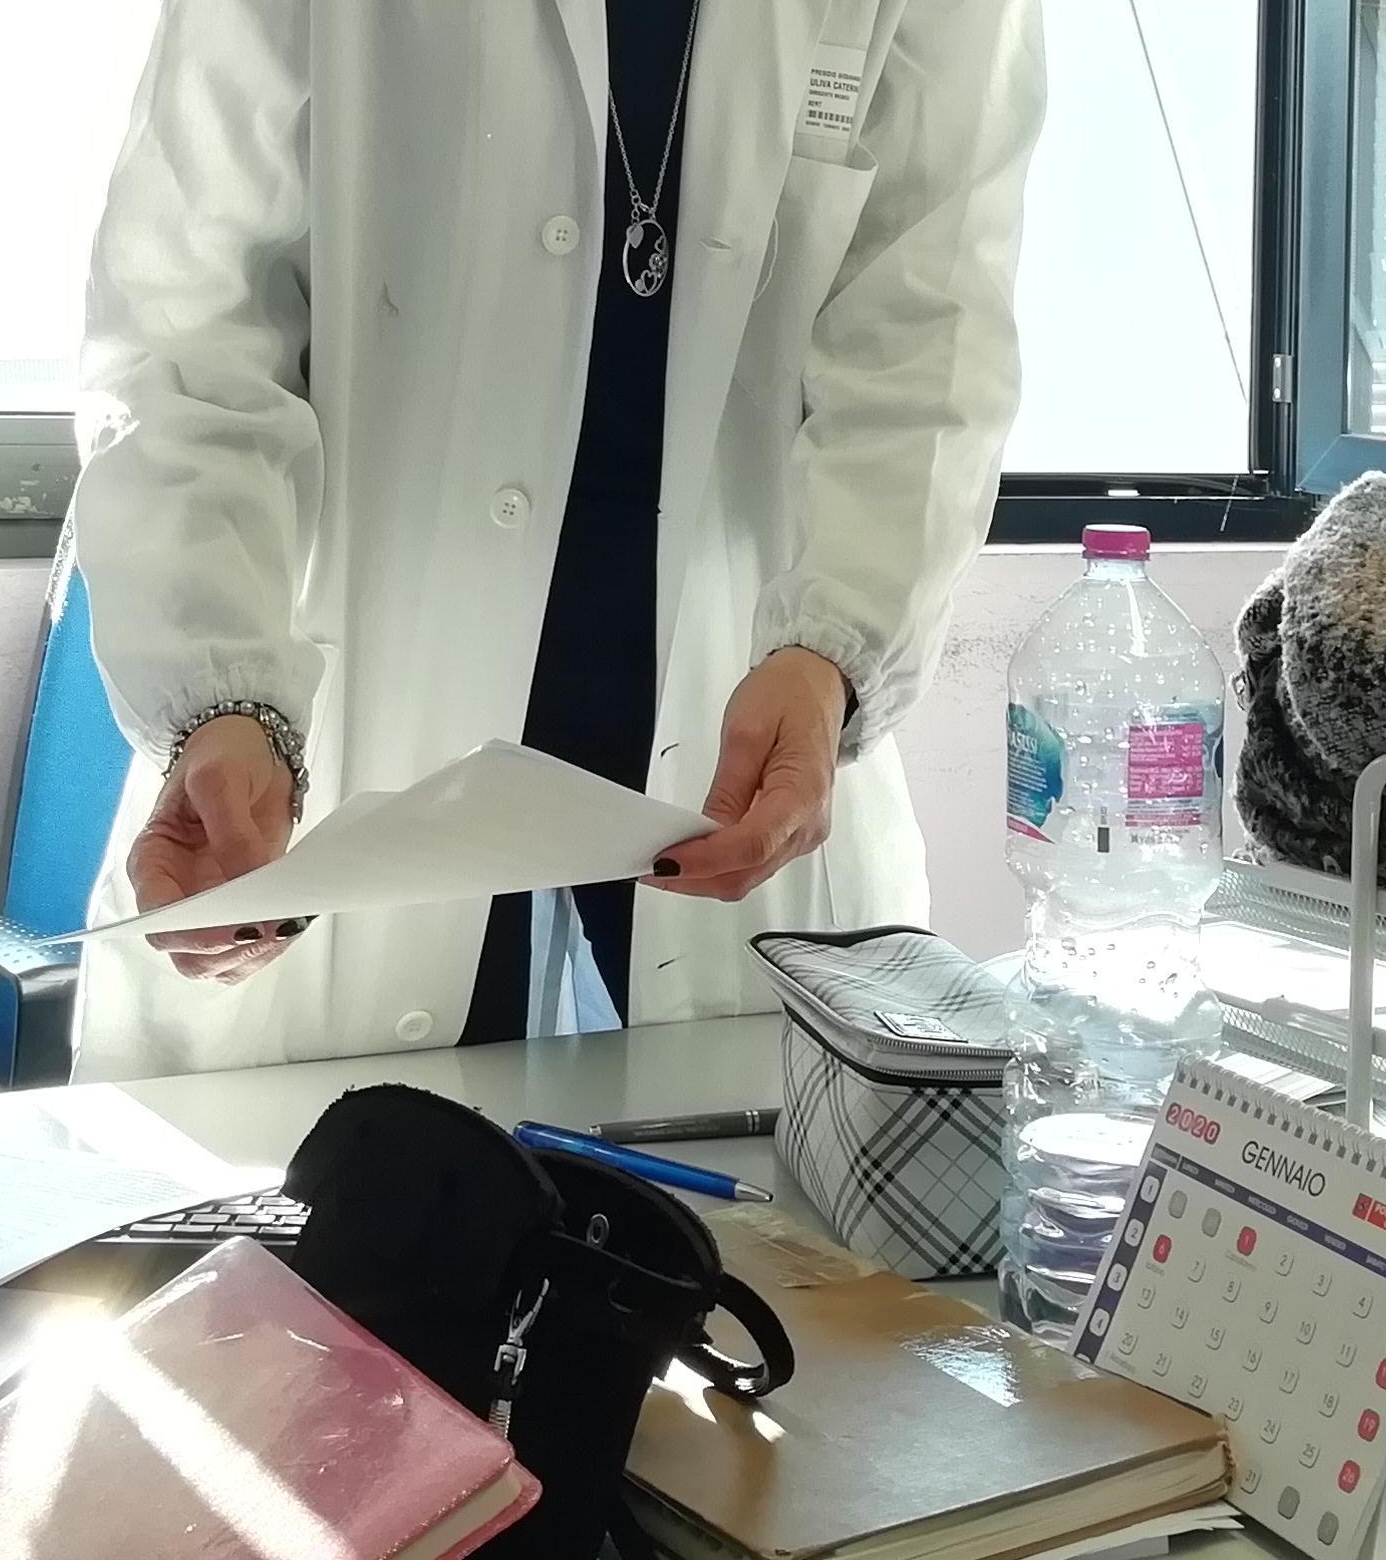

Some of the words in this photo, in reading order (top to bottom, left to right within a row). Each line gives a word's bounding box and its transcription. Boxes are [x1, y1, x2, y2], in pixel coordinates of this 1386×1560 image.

[1167, 1102, 1221, 1144] 2020
[1242, 1140, 1326, 1197] GENNAIO
[1280, 1254, 1288, 1267] 2
[1317, 1274, 1325, 1287] 3
[1140, 1288, 1152, 1302] 13
[1175, 1308, 1186, 1322] 14
[1209, 1327, 1221, 1342] 15
[1246, 1349, 1257, 1364] 16
[1283, 1370, 1296, 1386] 17
[1323, 1393, 1334, 1408] 18
[1363, 1417, 1375, 1432] 19
[1299, 1321, 1311, 1336] 10
[1340, 1344, 1352, 1359] 11
[1155, 1352, 1168, 1368] 21
[1192, 1374, 1204, 1389] 22
[1228, 1396, 1240, 1412] 23
[1263, 1420, 1276, 1435] 24
[1302, 1444, 1314, 1459] 25
[1343, 1469, 1356, 1485] 26
[1245, 1470, 1257, 1485] 31
